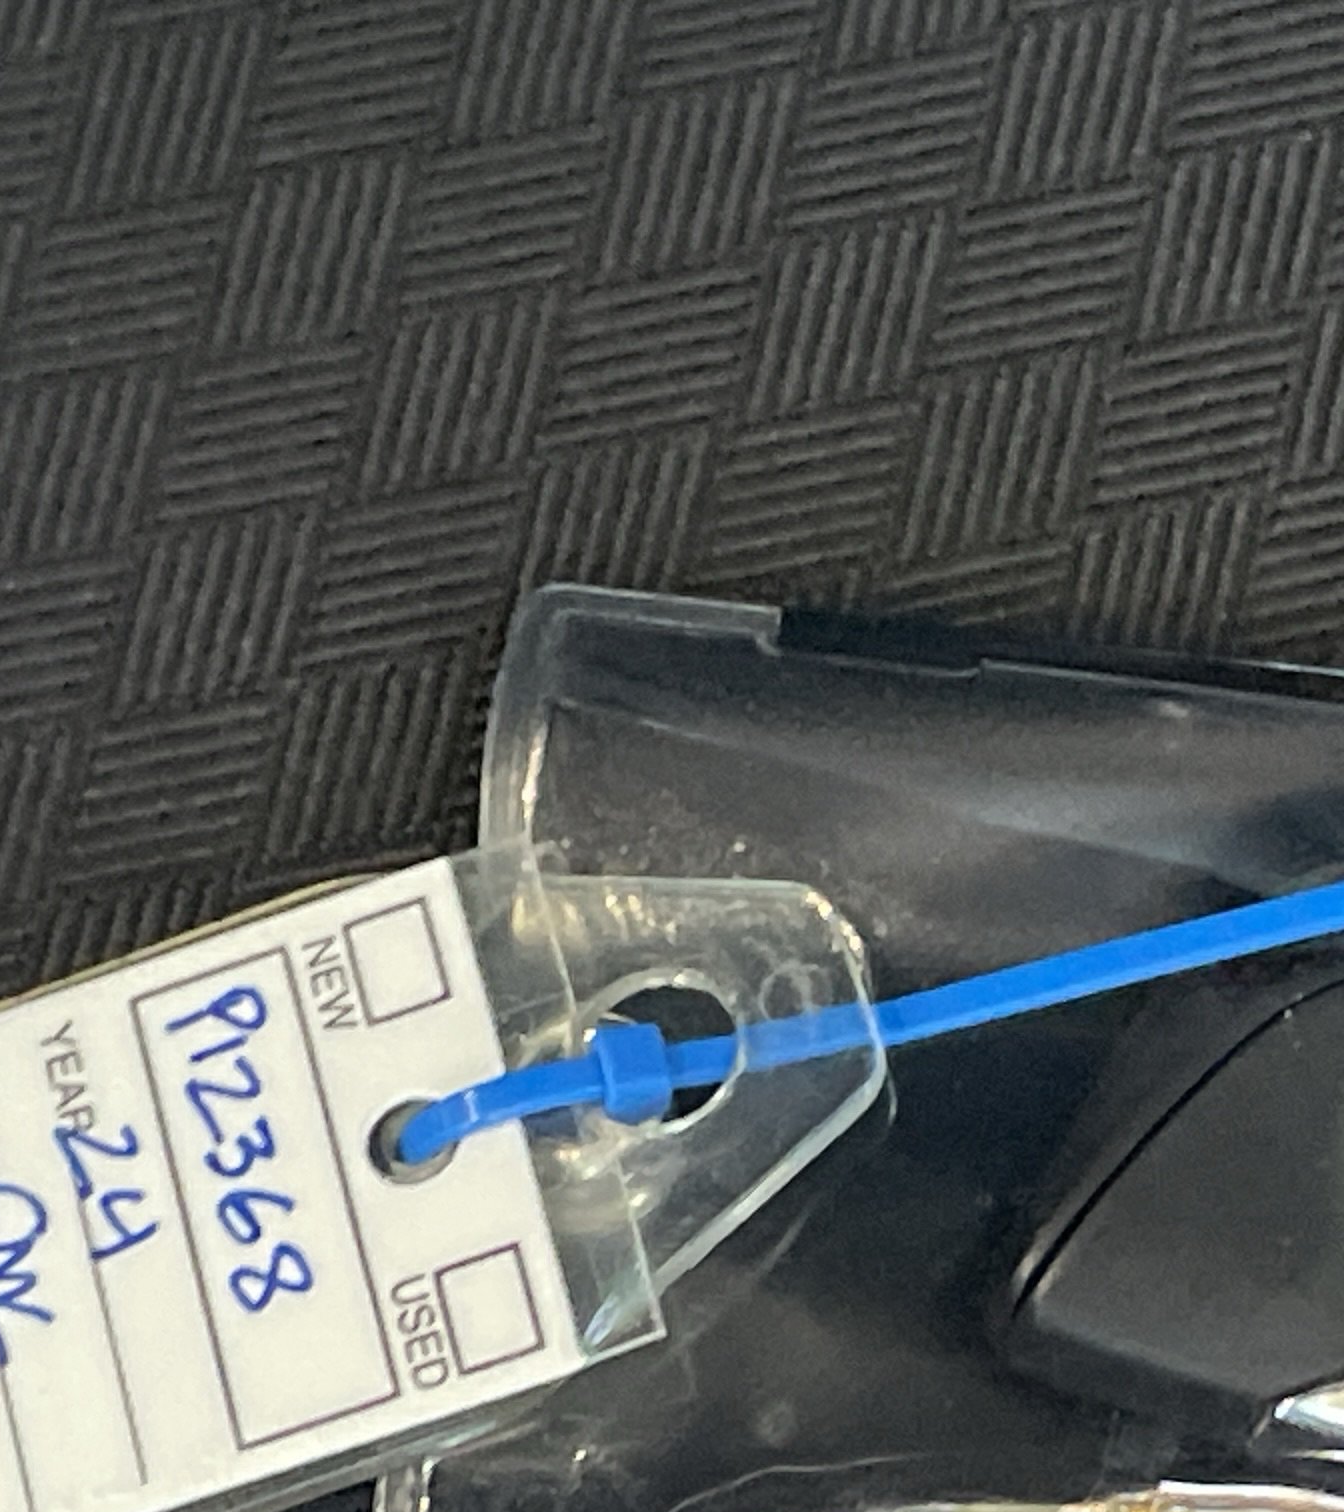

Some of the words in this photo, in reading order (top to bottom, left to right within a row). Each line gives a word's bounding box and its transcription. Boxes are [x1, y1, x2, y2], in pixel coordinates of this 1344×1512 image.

[301, 934, 357, 1031] NEW
[54, 1125, 159, 1262] 24
[165, 985, 312, 1312] P12368
[390, 1273, 450, 1392] USED
